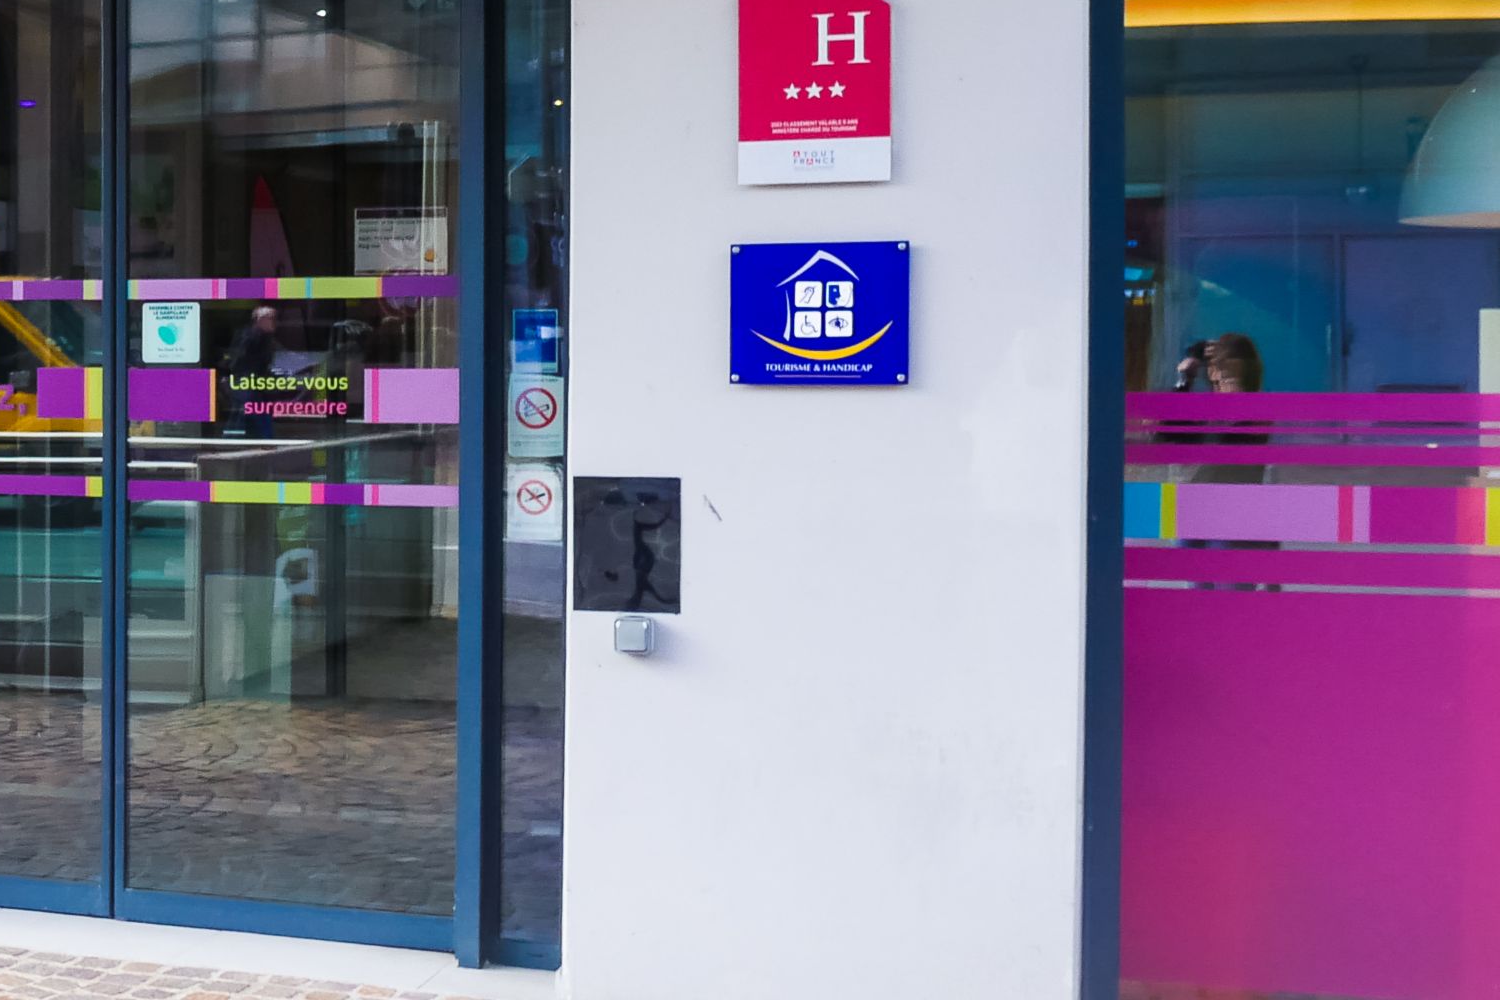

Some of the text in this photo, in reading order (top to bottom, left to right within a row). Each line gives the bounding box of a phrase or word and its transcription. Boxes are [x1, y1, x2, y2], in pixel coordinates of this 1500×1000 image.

[812, 11, 871, 66] H
[765, 363, 873, 372] TOURISME & HANDICAP
[229, 373, 349, 390] Laissez-vous
[244, 399, 348, 418] surprendre
